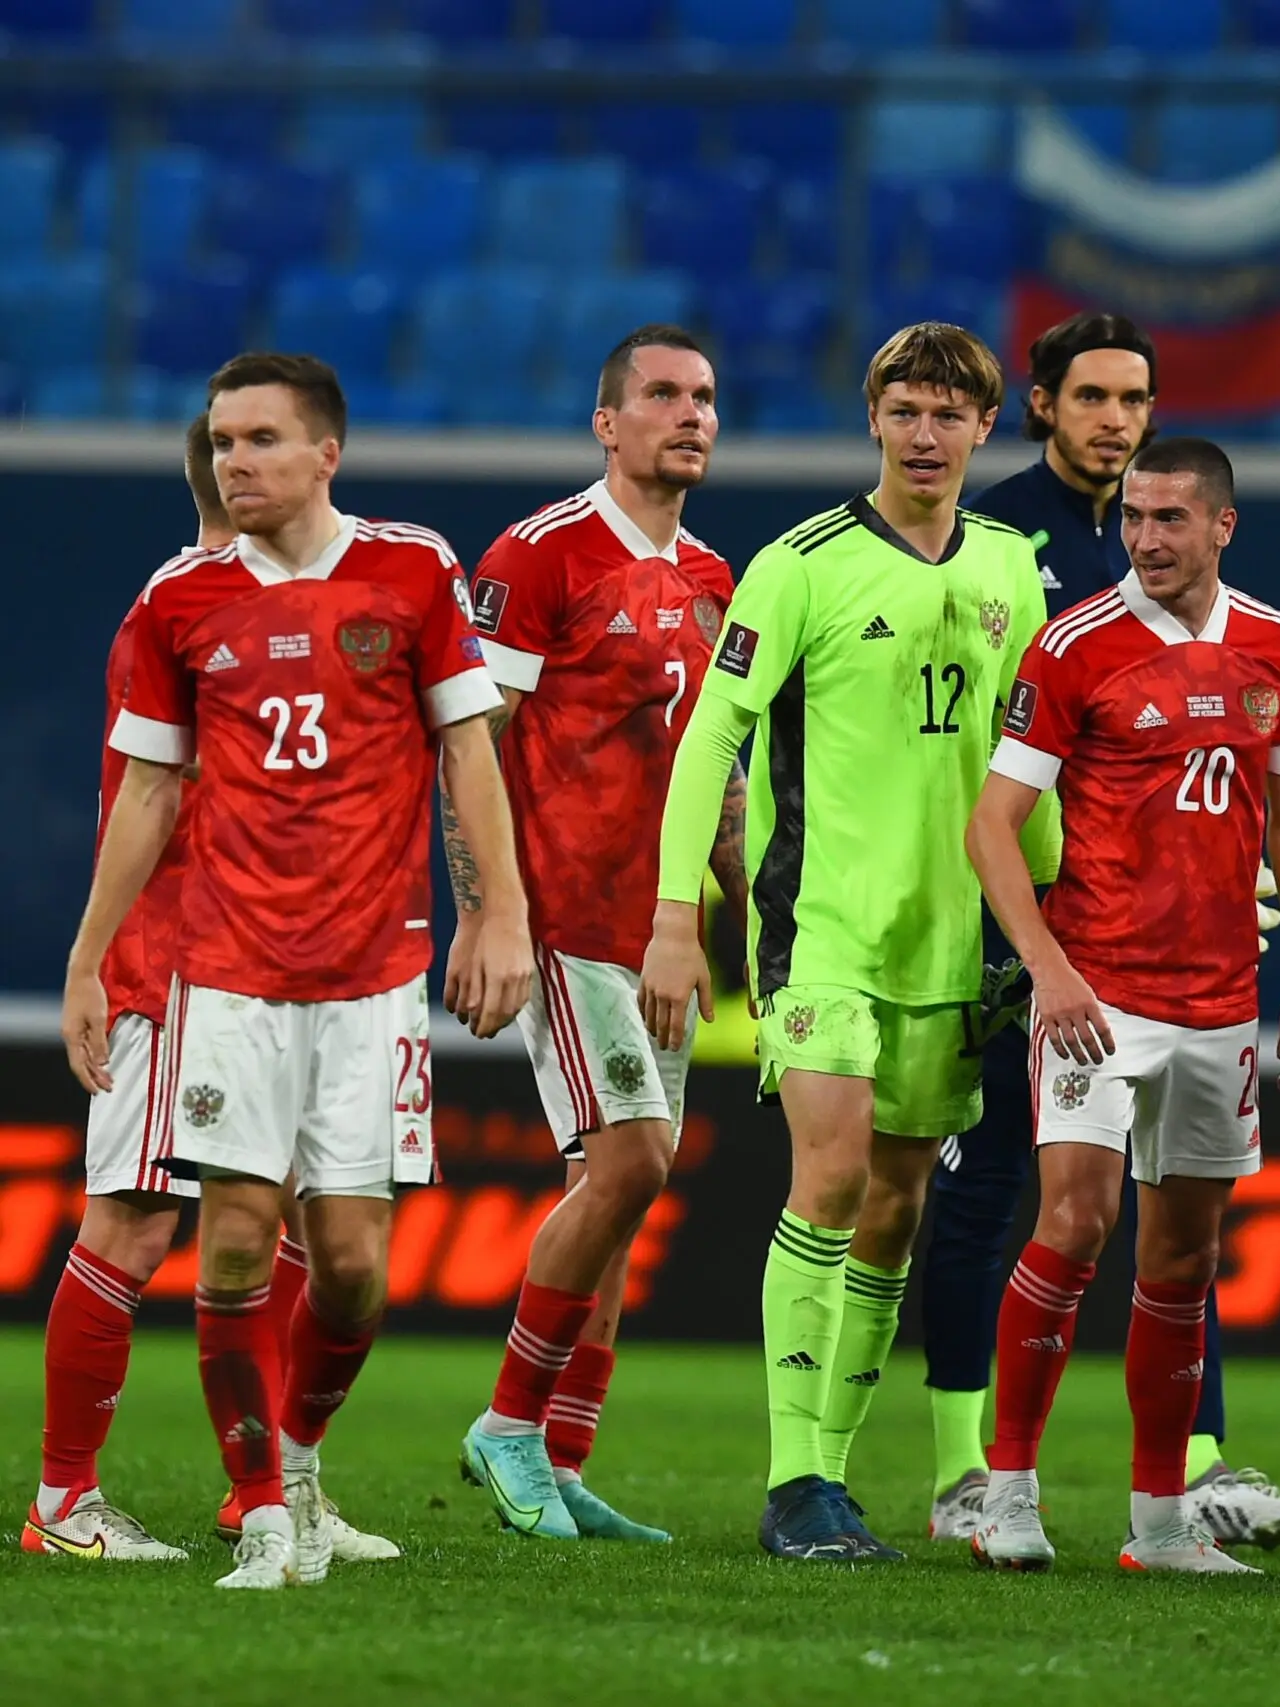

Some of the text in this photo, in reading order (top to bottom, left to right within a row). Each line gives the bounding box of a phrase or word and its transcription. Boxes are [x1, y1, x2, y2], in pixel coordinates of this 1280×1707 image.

[606, 625, 638, 634] adidas
[860, 630, 896, 641] adidas
[664, 660, 687, 728] 7
[919, 662, 966, 735] 12
[1133, 716, 1169, 730] adidas
[259, 692, 328, 770] 23
[1176, 746, 1235, 815] 20
[394, 1036, 432, 1114] 23
[1237, 1045, 1259, 1118] 2
[776, 1361, 823, 1371] adidas
